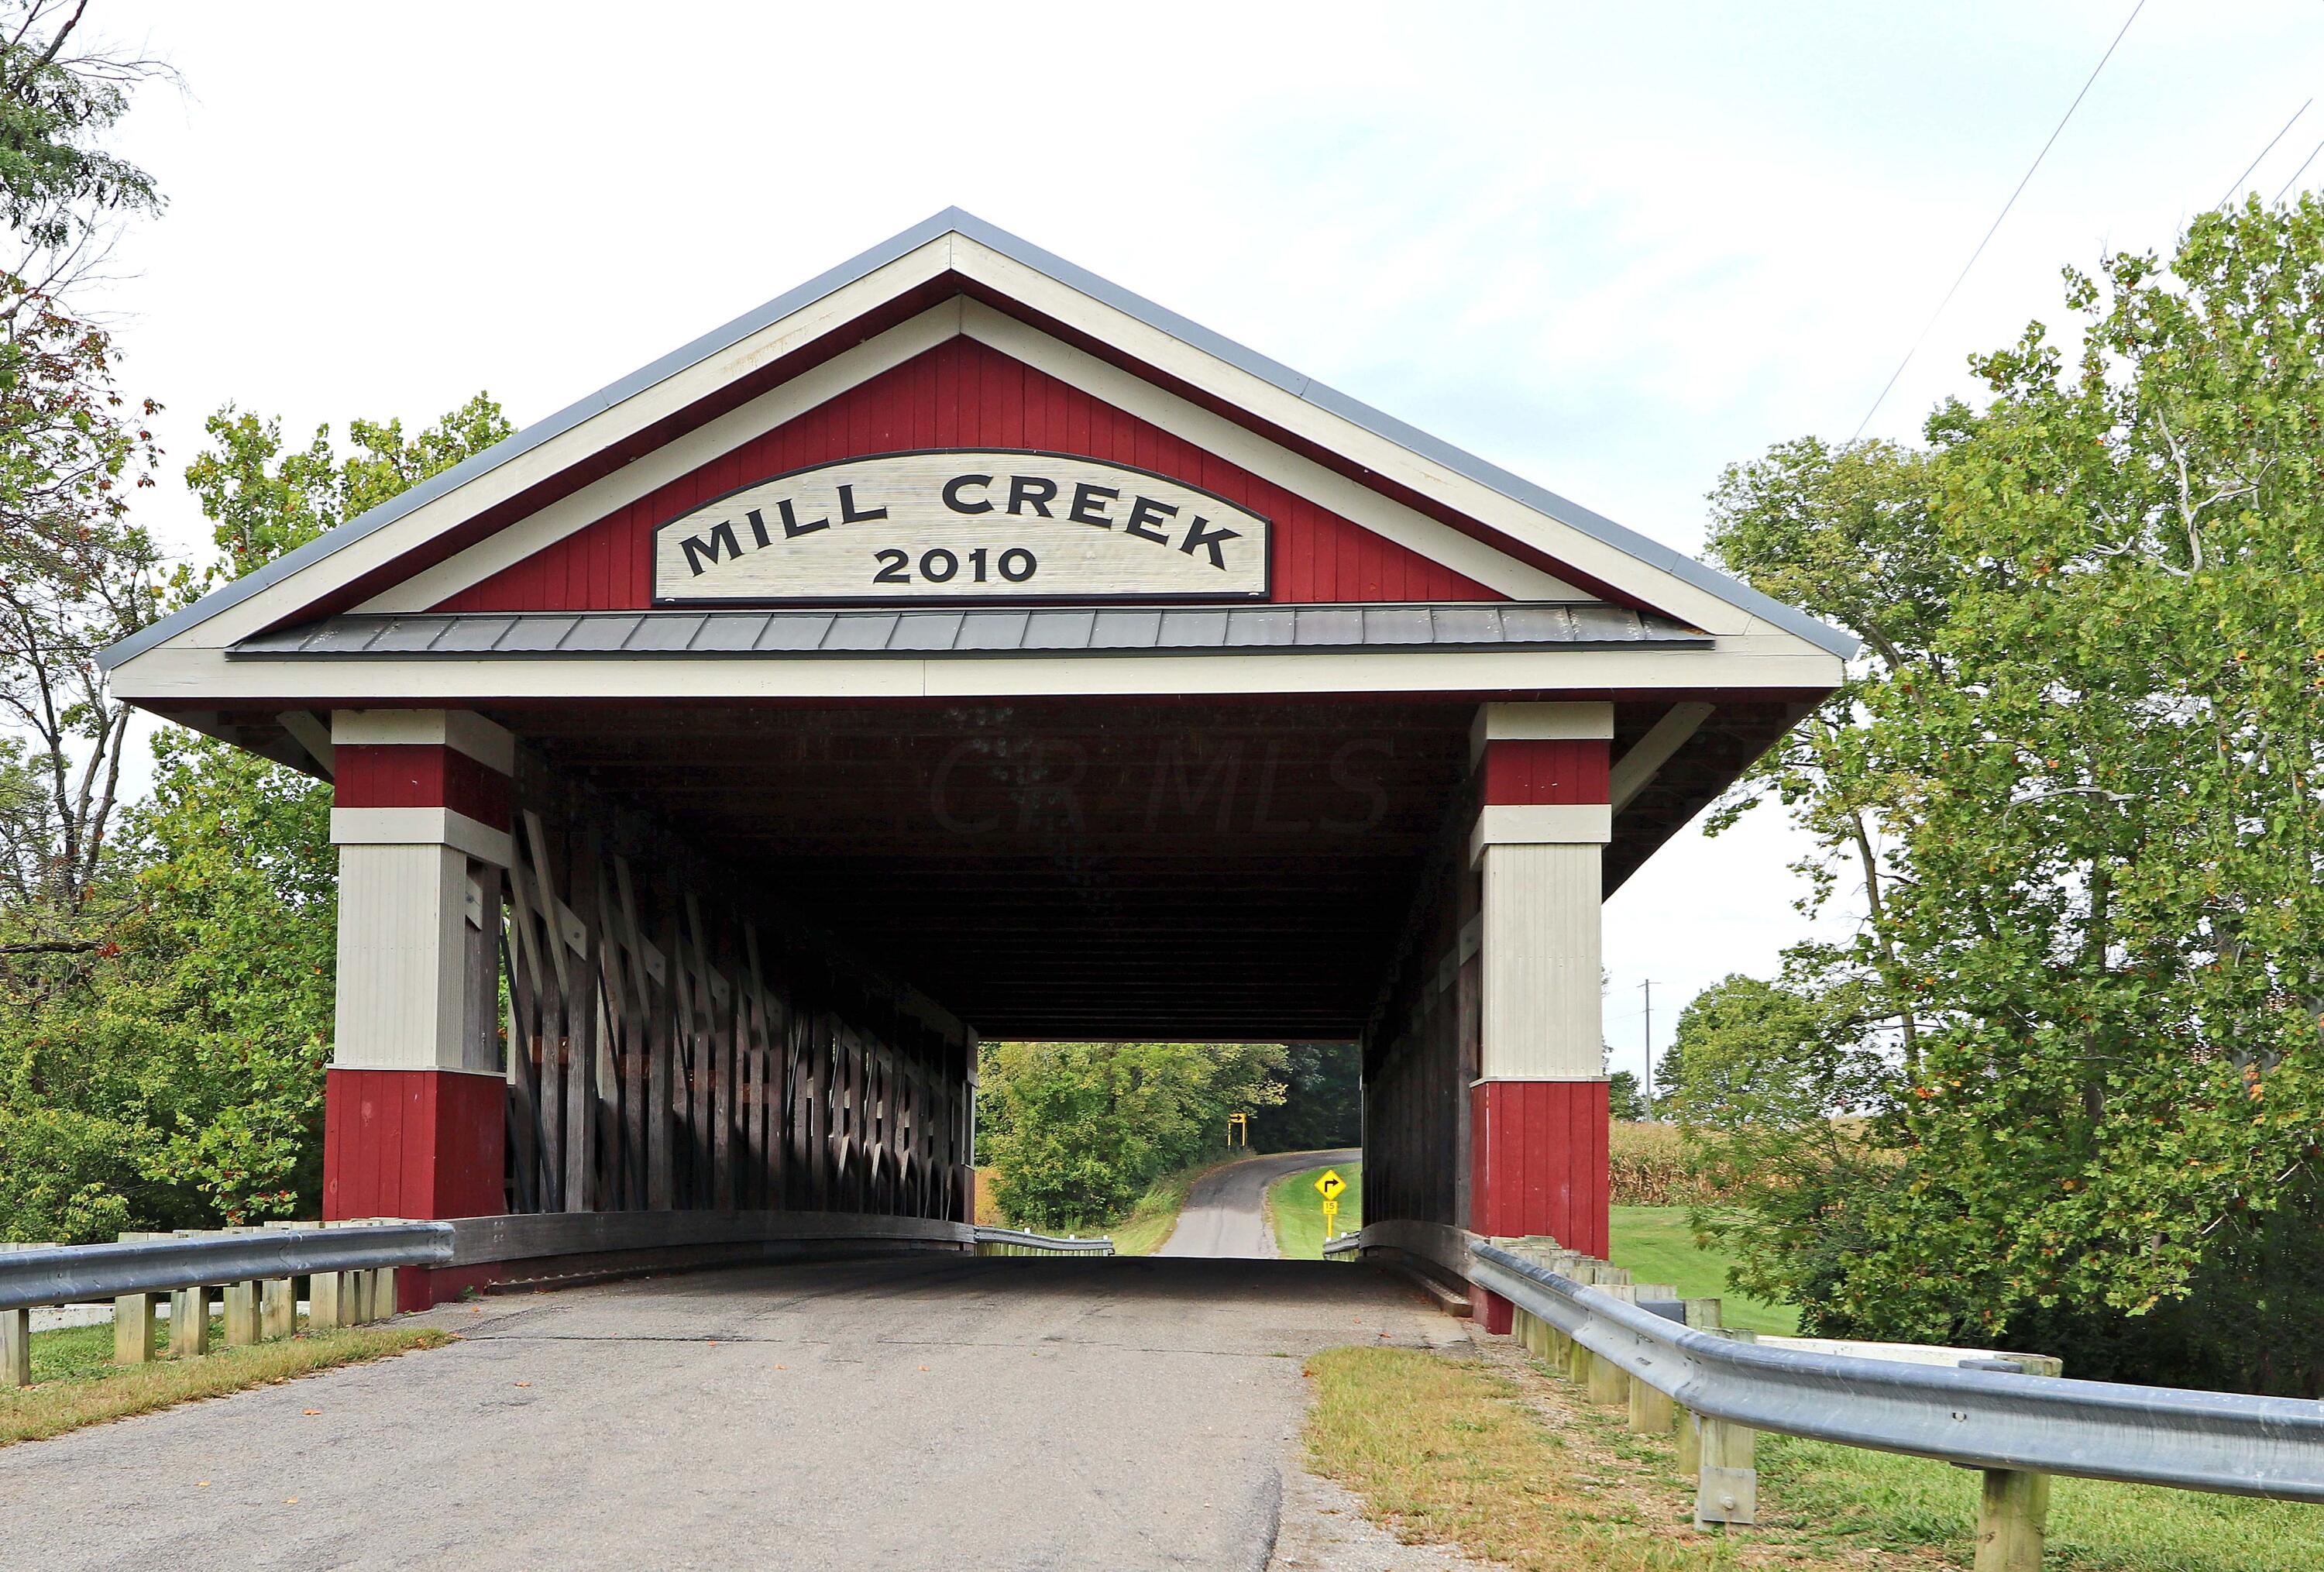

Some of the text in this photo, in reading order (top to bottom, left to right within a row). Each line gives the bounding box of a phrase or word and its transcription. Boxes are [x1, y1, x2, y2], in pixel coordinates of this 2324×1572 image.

[679, 475, 1243, 577] MILL CREEK
[874, 549, 1037, 583] 2010
